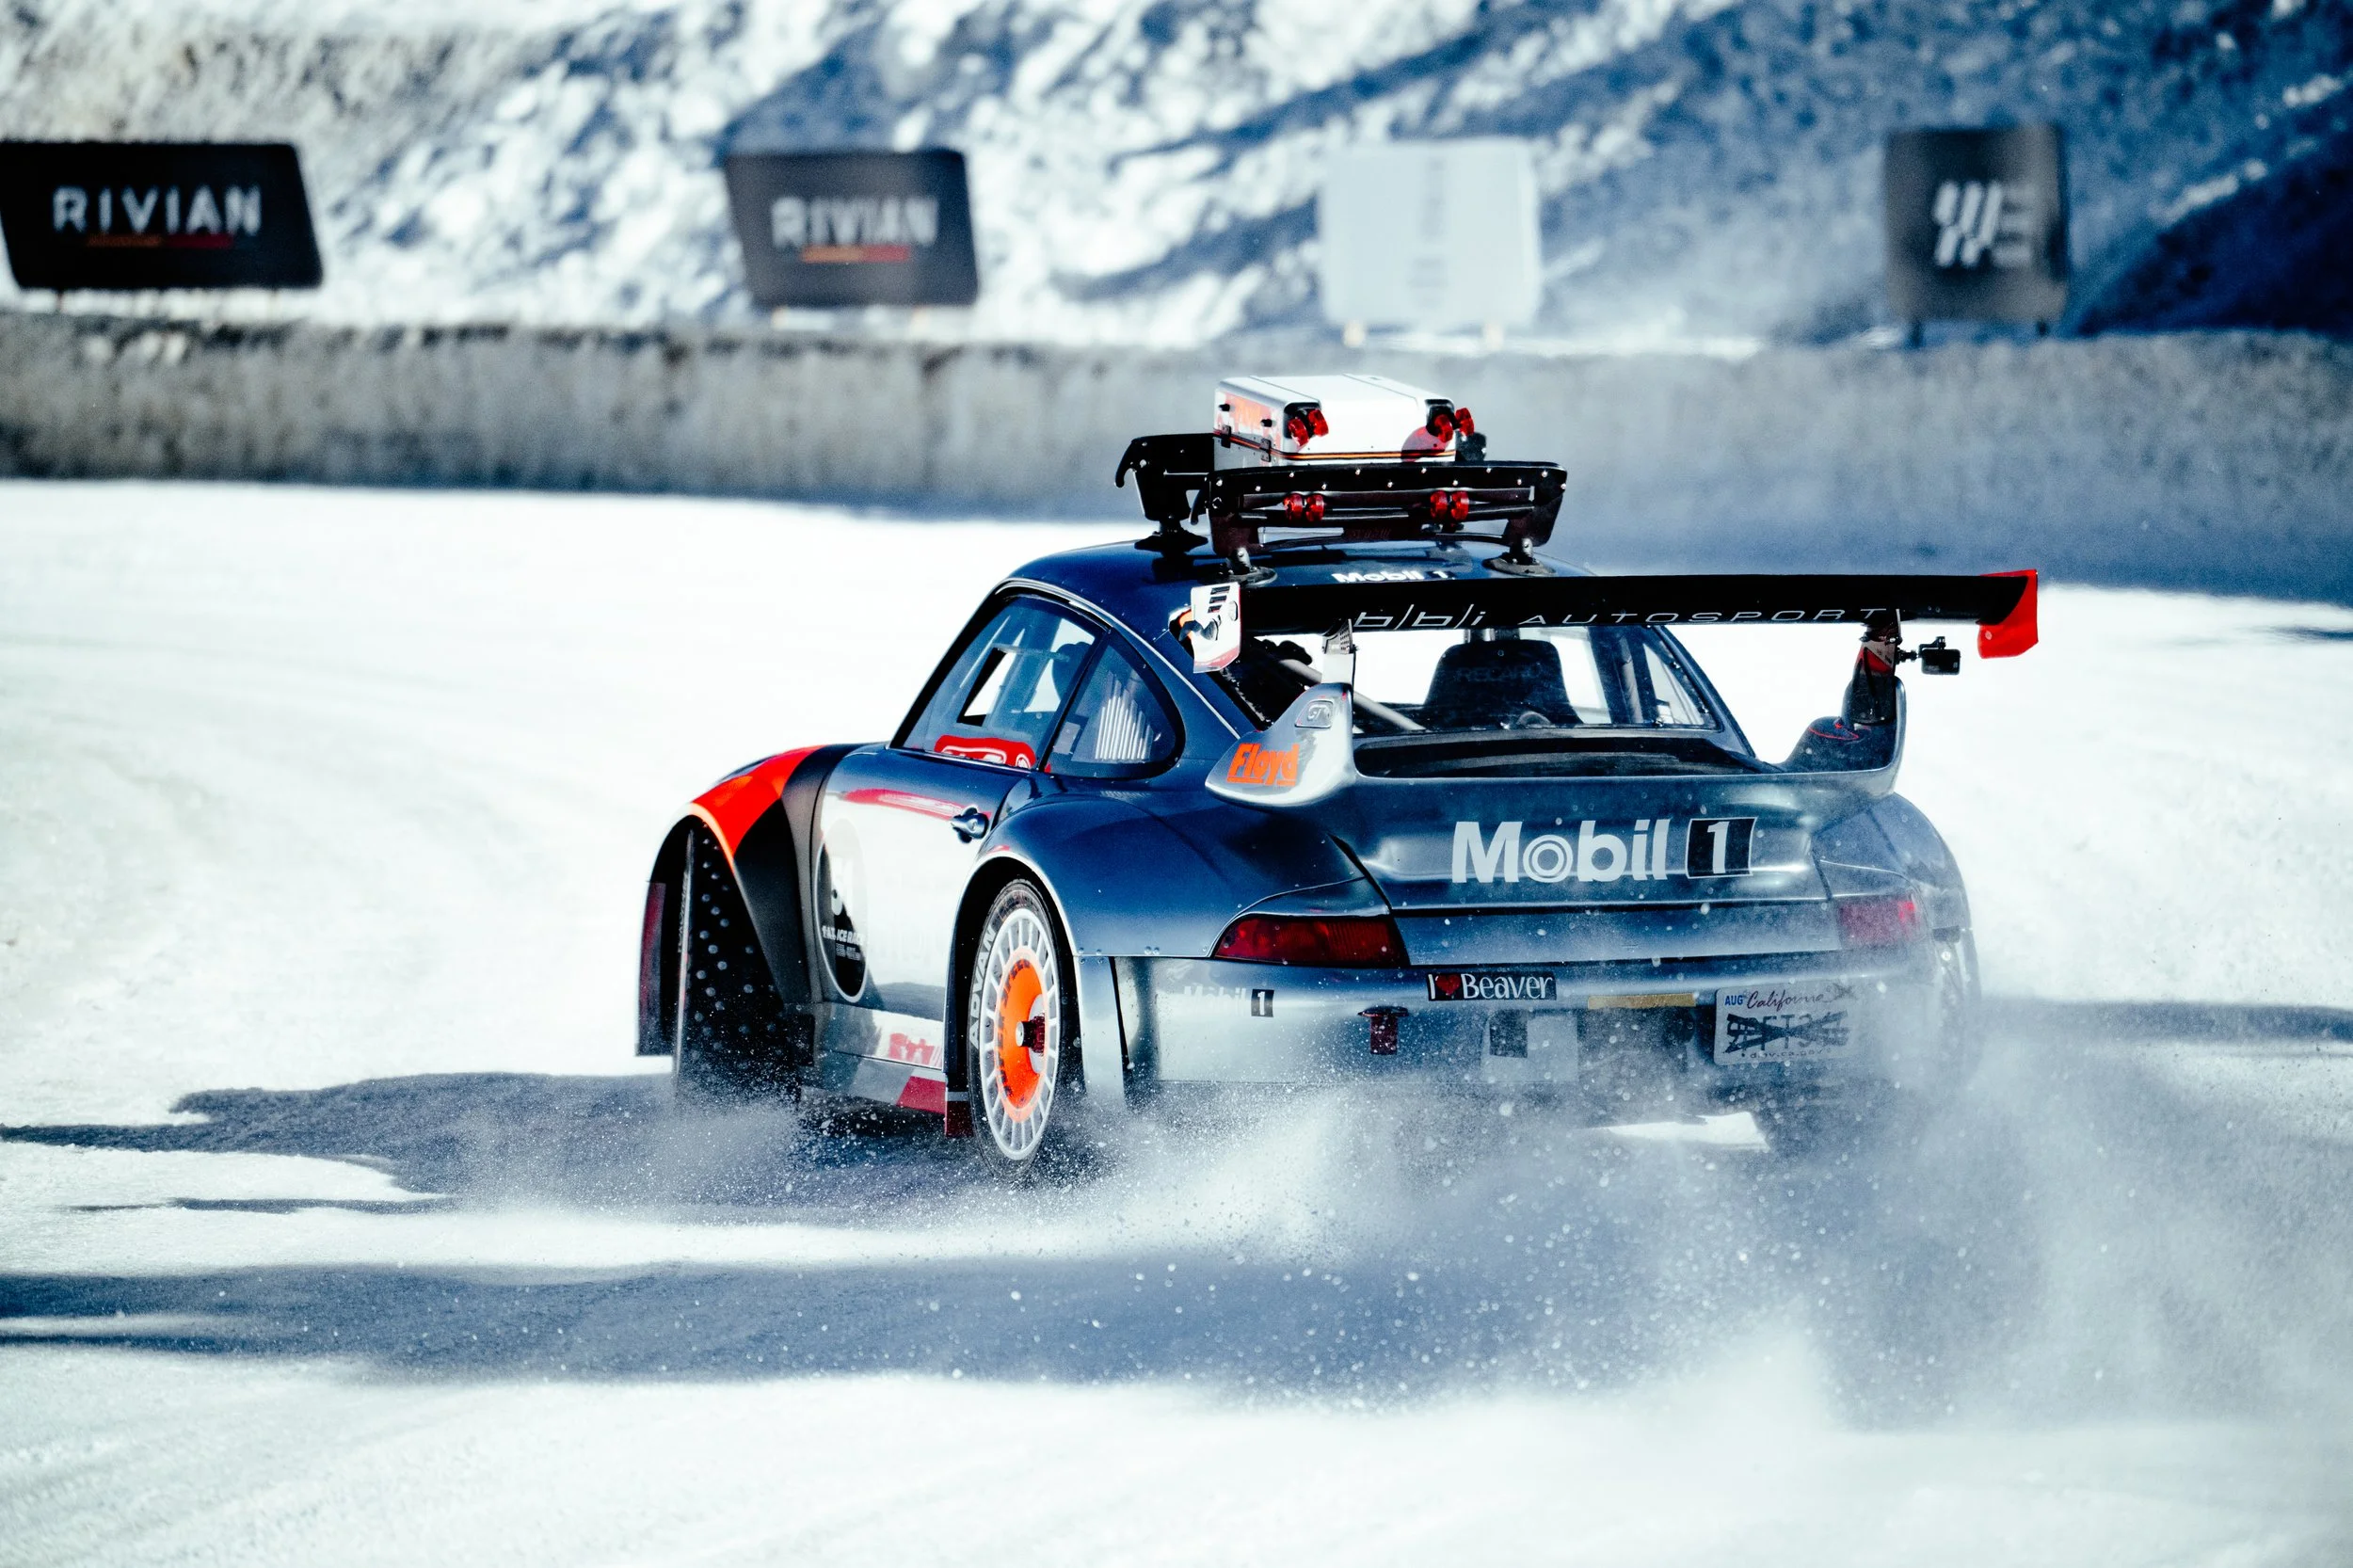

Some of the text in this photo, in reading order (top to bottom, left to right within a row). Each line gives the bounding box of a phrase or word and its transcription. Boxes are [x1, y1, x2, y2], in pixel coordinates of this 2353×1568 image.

[52, 185, 261, 234] RIVIAN
[1331, 570, 1424, 583] Mobil
[1517, 608, 1887, 625] AUTOSPORT
[1226, 743, 1300, 787] Floyd
[1452, 819, 1730, 883] Mobil 1
[837, 928, 847, 943] ICE
[968, 924, 996, 1049] ADVAN
[1428, 973, 1553, 1000] I Beaver
[1724, 995, 1744, 1006] AUG
